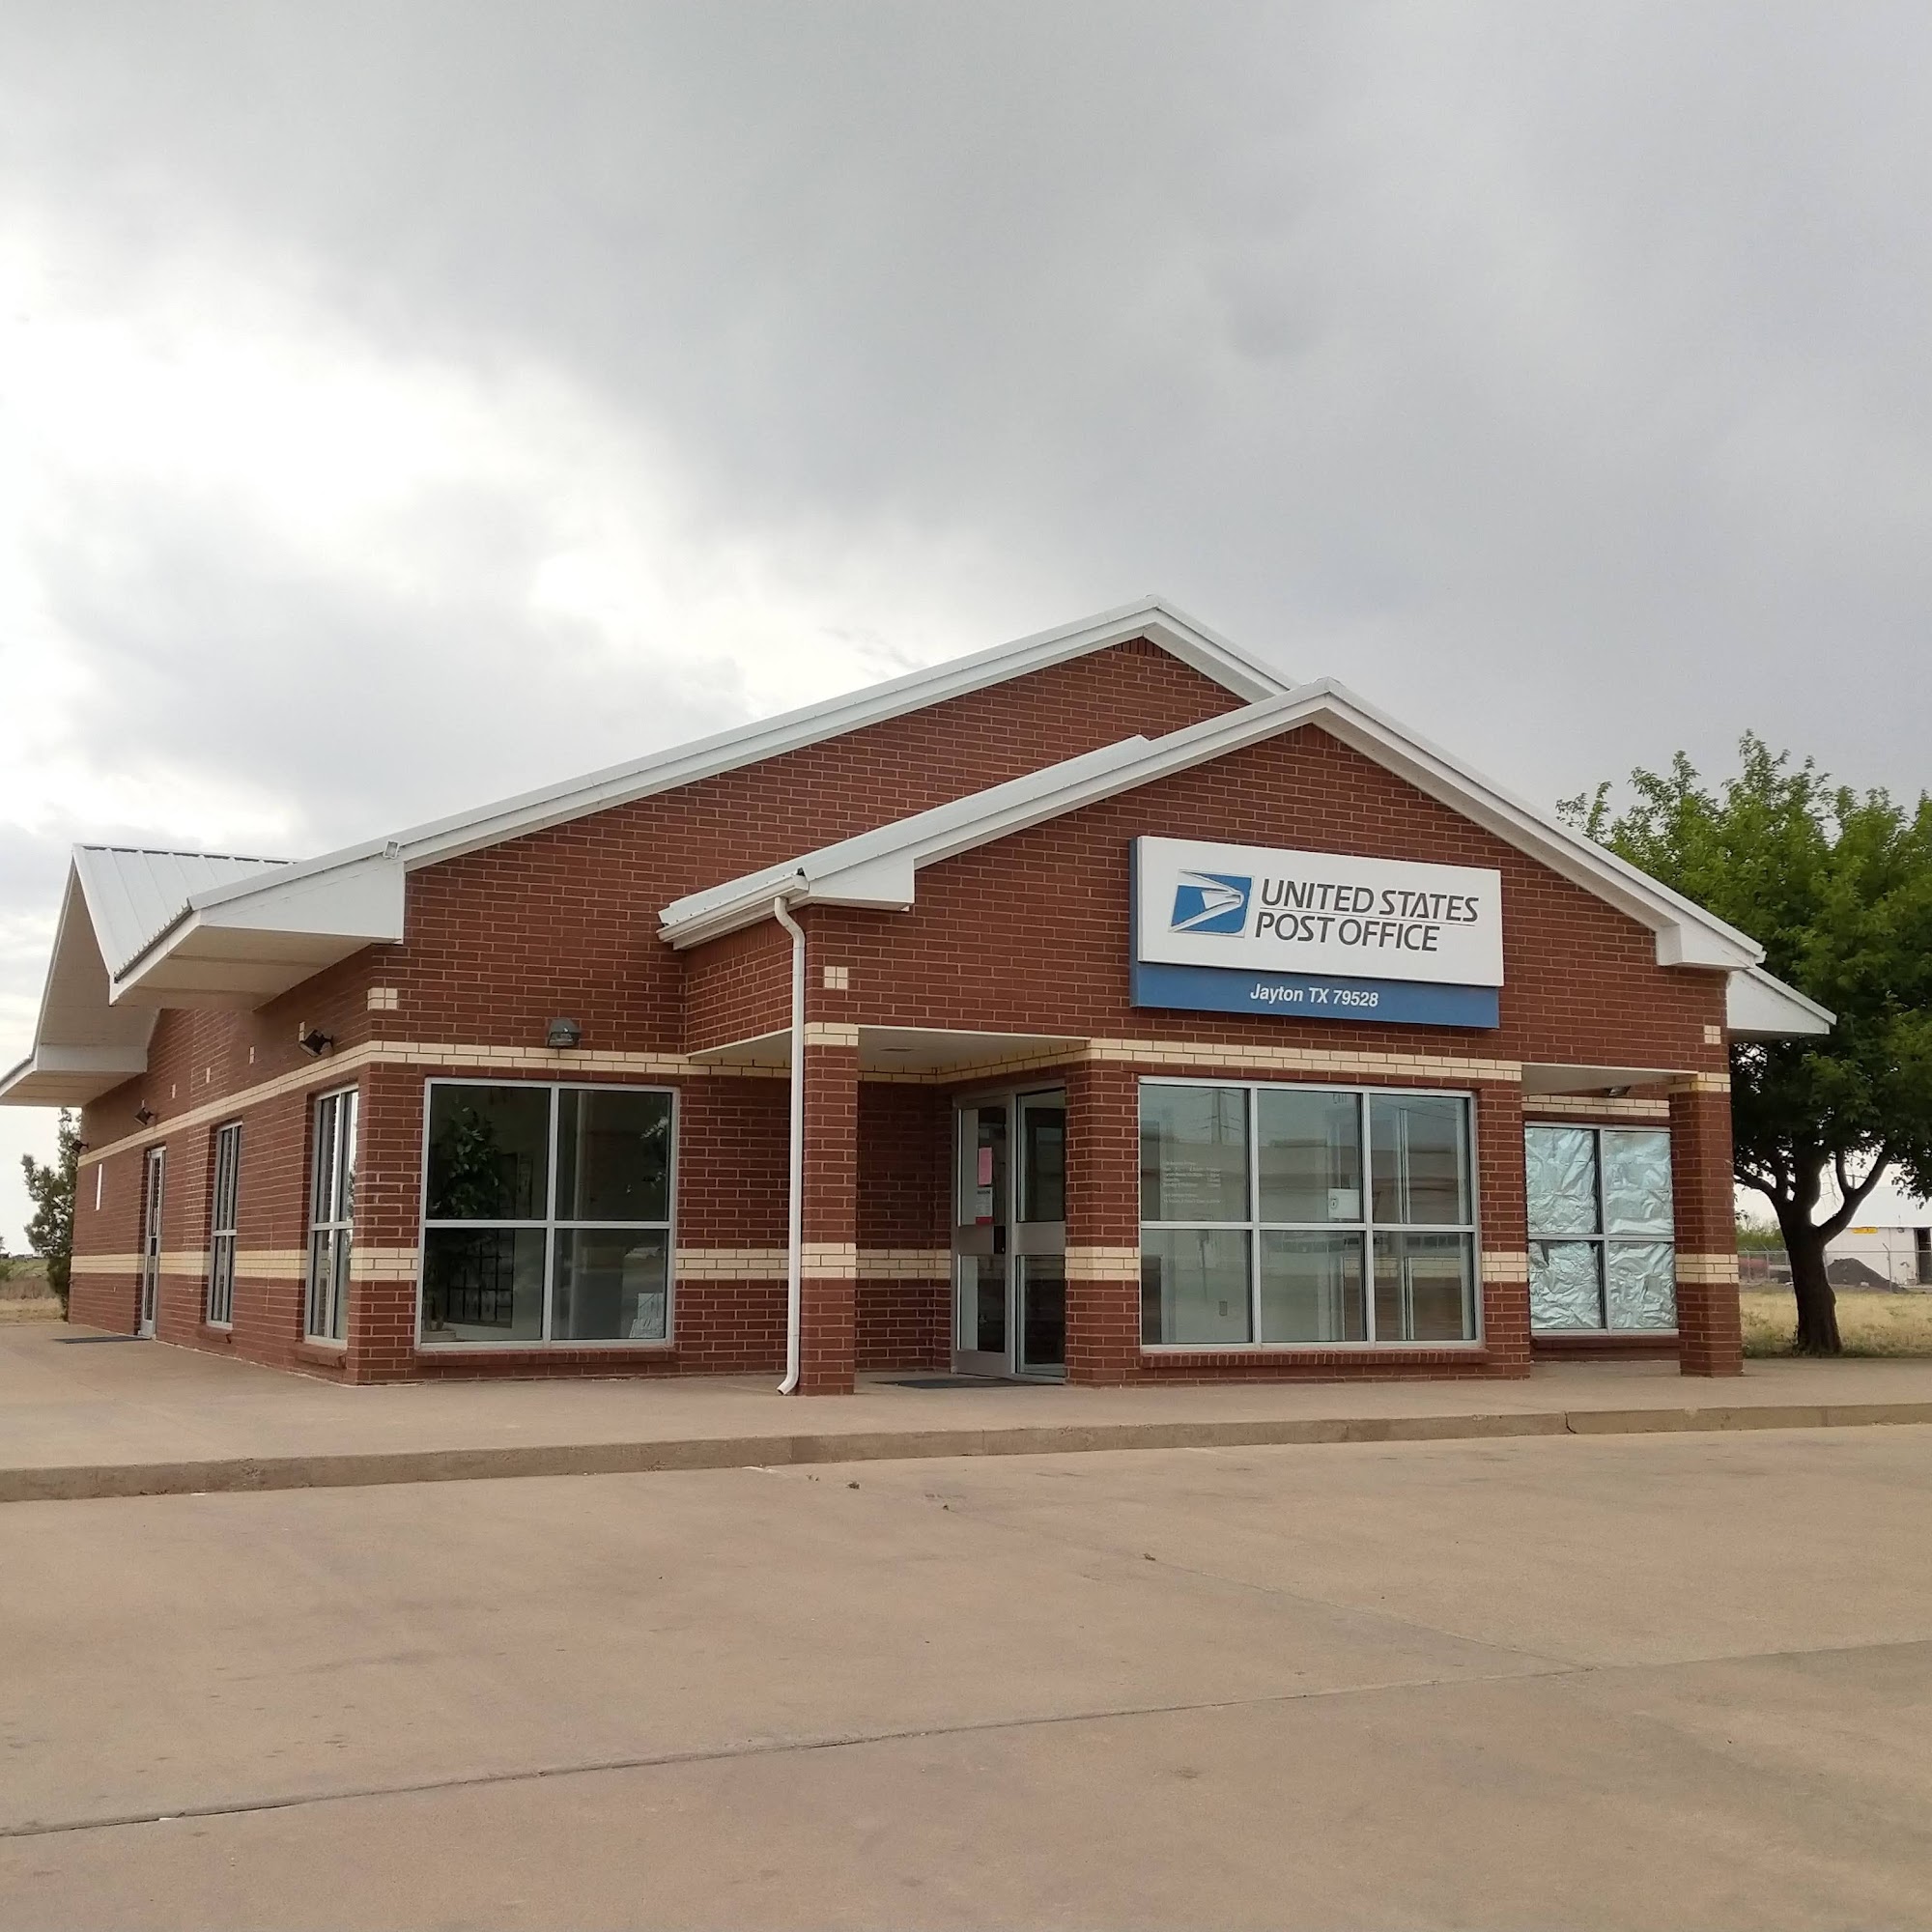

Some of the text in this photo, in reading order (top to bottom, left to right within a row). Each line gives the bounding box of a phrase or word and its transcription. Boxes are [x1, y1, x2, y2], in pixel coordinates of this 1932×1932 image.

[1262, 878, 1479, 923] UNITED STATES
[1255, 911, 1440, 952] POST OFFICE
[1250, 983, 1379, 1007] Jayton TX 79528
